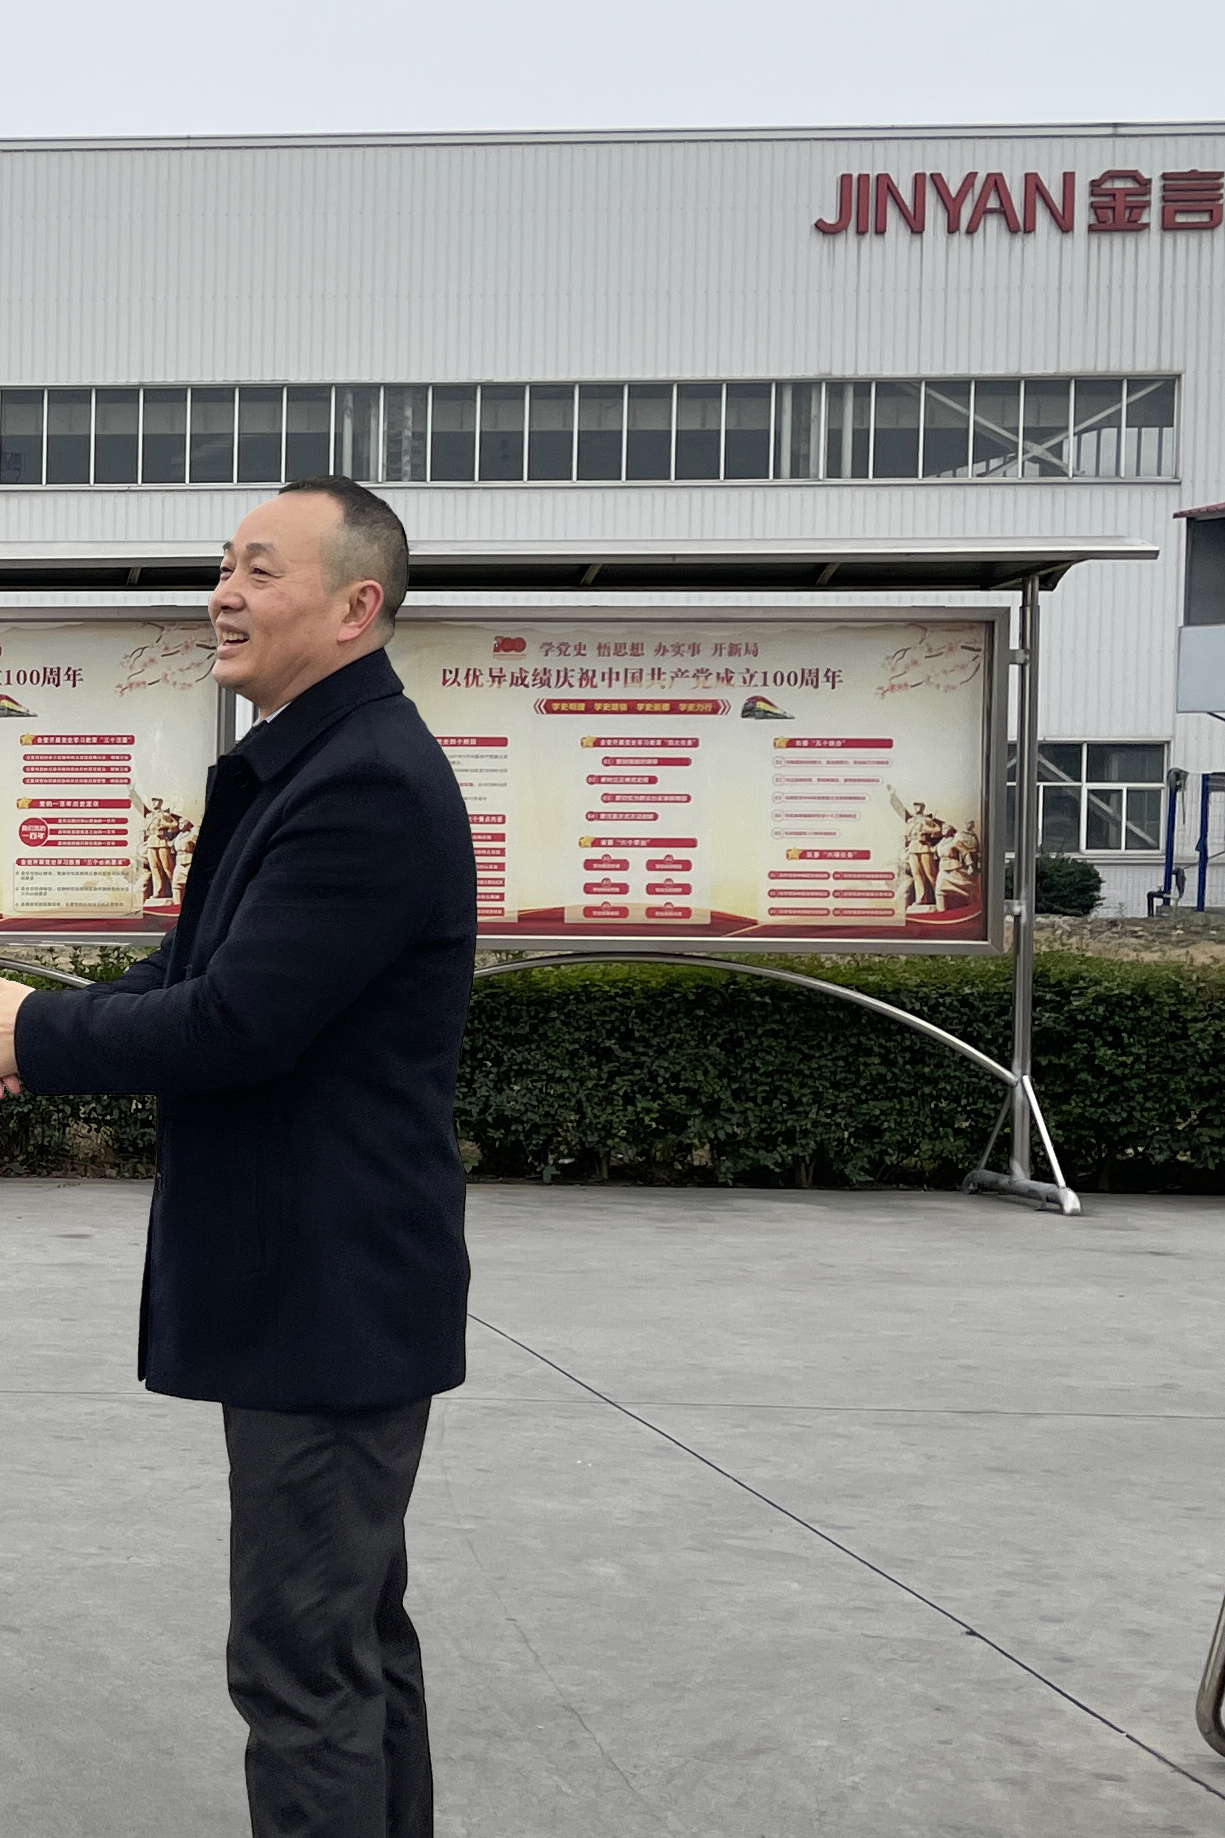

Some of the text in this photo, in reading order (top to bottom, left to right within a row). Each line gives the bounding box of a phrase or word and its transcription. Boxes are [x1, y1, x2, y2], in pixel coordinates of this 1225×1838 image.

[814, 171, 1076, 235] JINYAN
[1088, 169, 1225, 232] 金言
[539, 641, 587, 658] 学党史
[597, 641, 645, 658] 悟思想
[654, 641, 702, 658] 办实事
[712, 641, 759, 658] 开新局
[441, 667, 844, 690] 以优异成绩庆祝中国共产党成立100周年
